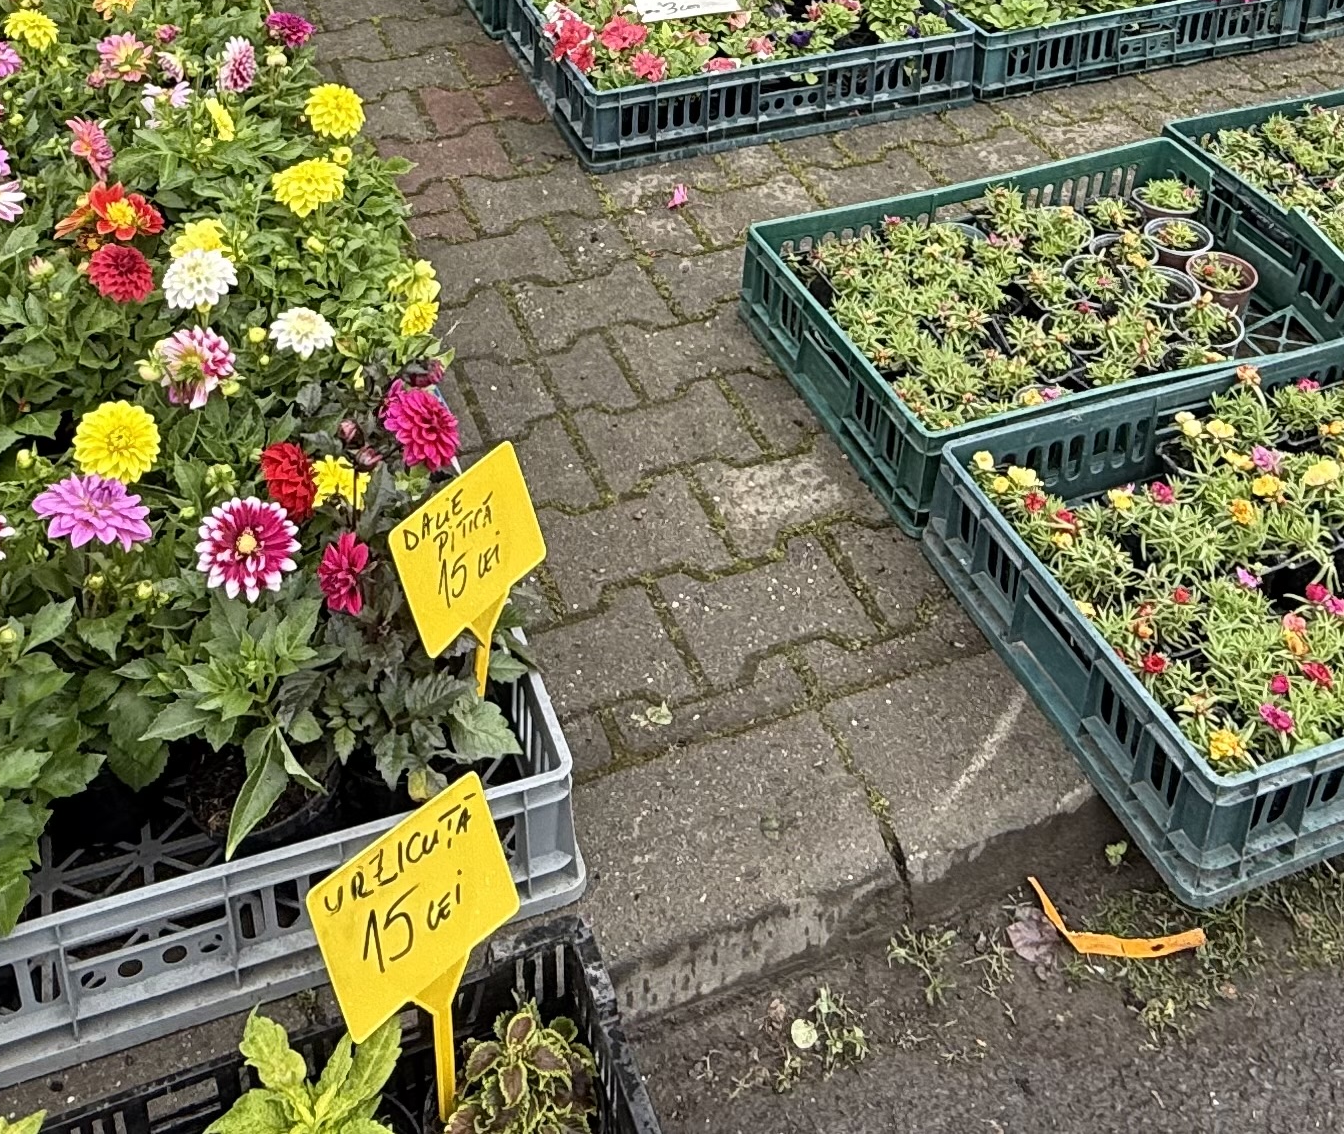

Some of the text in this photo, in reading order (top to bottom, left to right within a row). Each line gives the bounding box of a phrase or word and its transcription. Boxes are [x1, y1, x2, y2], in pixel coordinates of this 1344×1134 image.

[402, 488, 464, 552] DALIE
[437, 530, 501, 609] 15 LEI
[362, 868, 463, 974] 15 LEI
